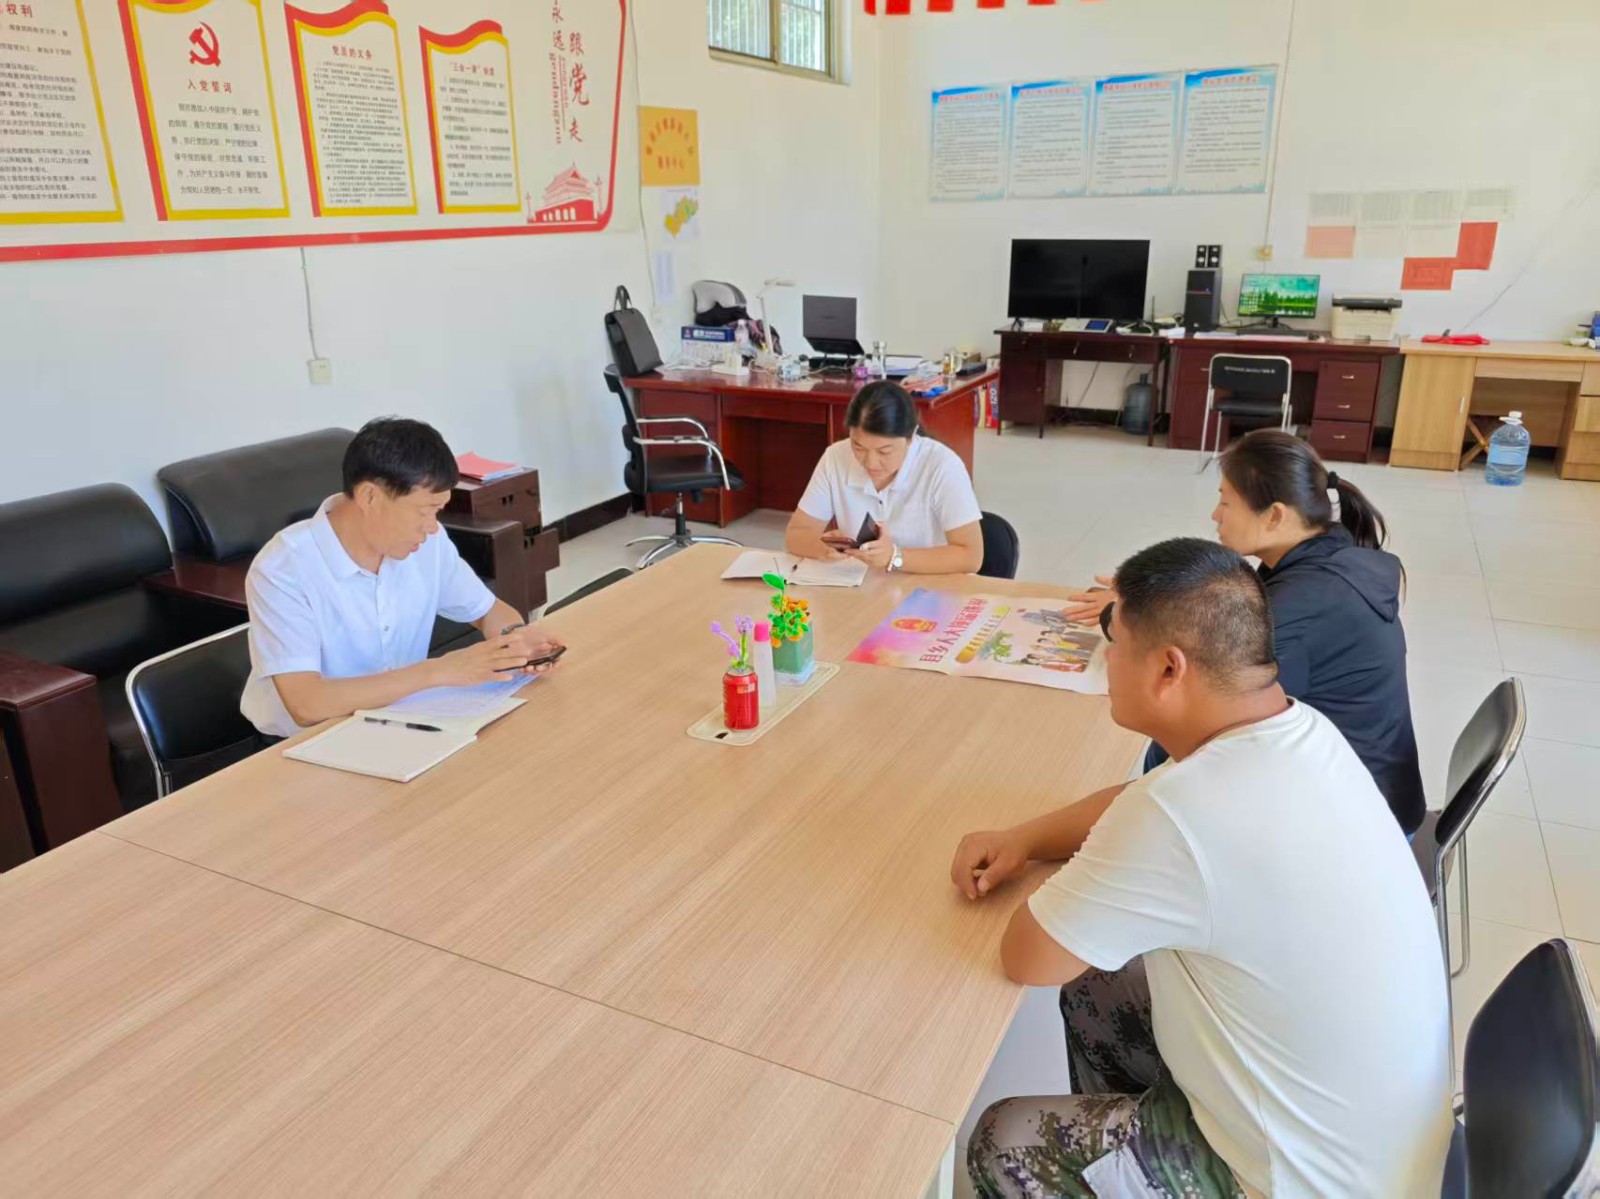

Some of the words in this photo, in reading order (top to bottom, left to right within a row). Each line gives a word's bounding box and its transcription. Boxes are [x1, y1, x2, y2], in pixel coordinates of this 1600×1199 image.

[187, 79, 232, 94] 入党誓词
[569, 32, 590, 143] 跟党走
